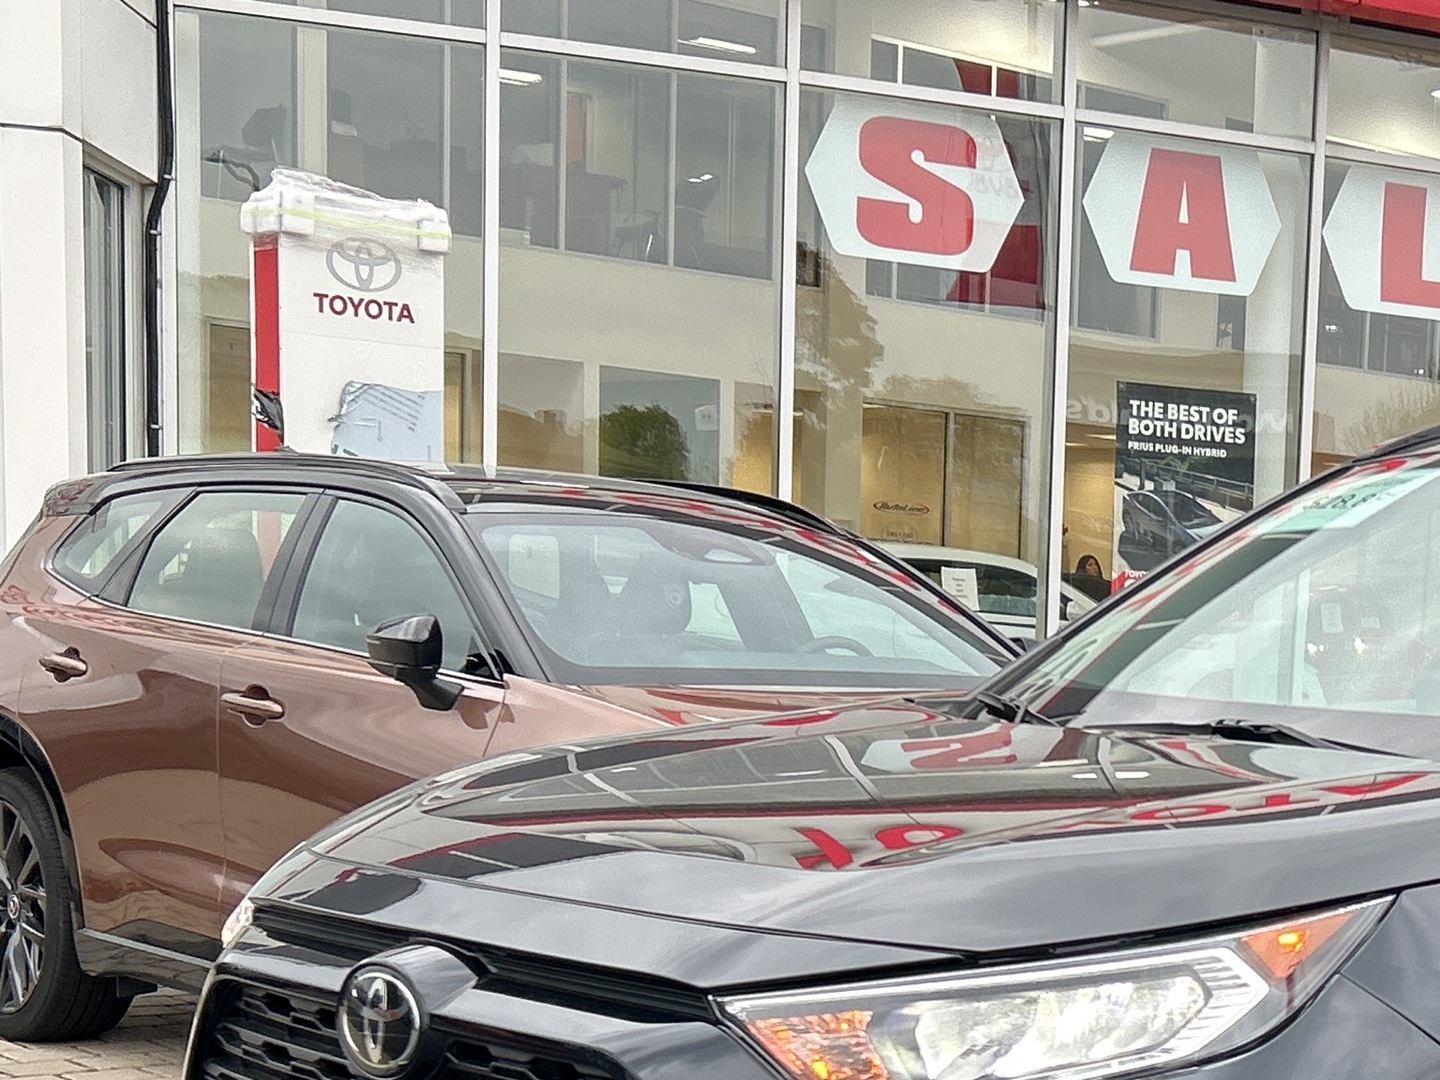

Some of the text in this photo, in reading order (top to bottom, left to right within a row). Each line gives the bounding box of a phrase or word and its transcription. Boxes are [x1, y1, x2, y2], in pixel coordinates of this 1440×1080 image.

[312, 291, 415, 324] TOYOTA
[1129, 399, 1164, 419] THE
[1167, 403, 1211, 424] BEST
[1212, 407, 1239, 425] OF
[1128, 417, 1246, 445] BOTH DRIVES
[1154, 442, 1192, 456] PLUG-IN
[1193, 447, 1227, 459] HYBRID
